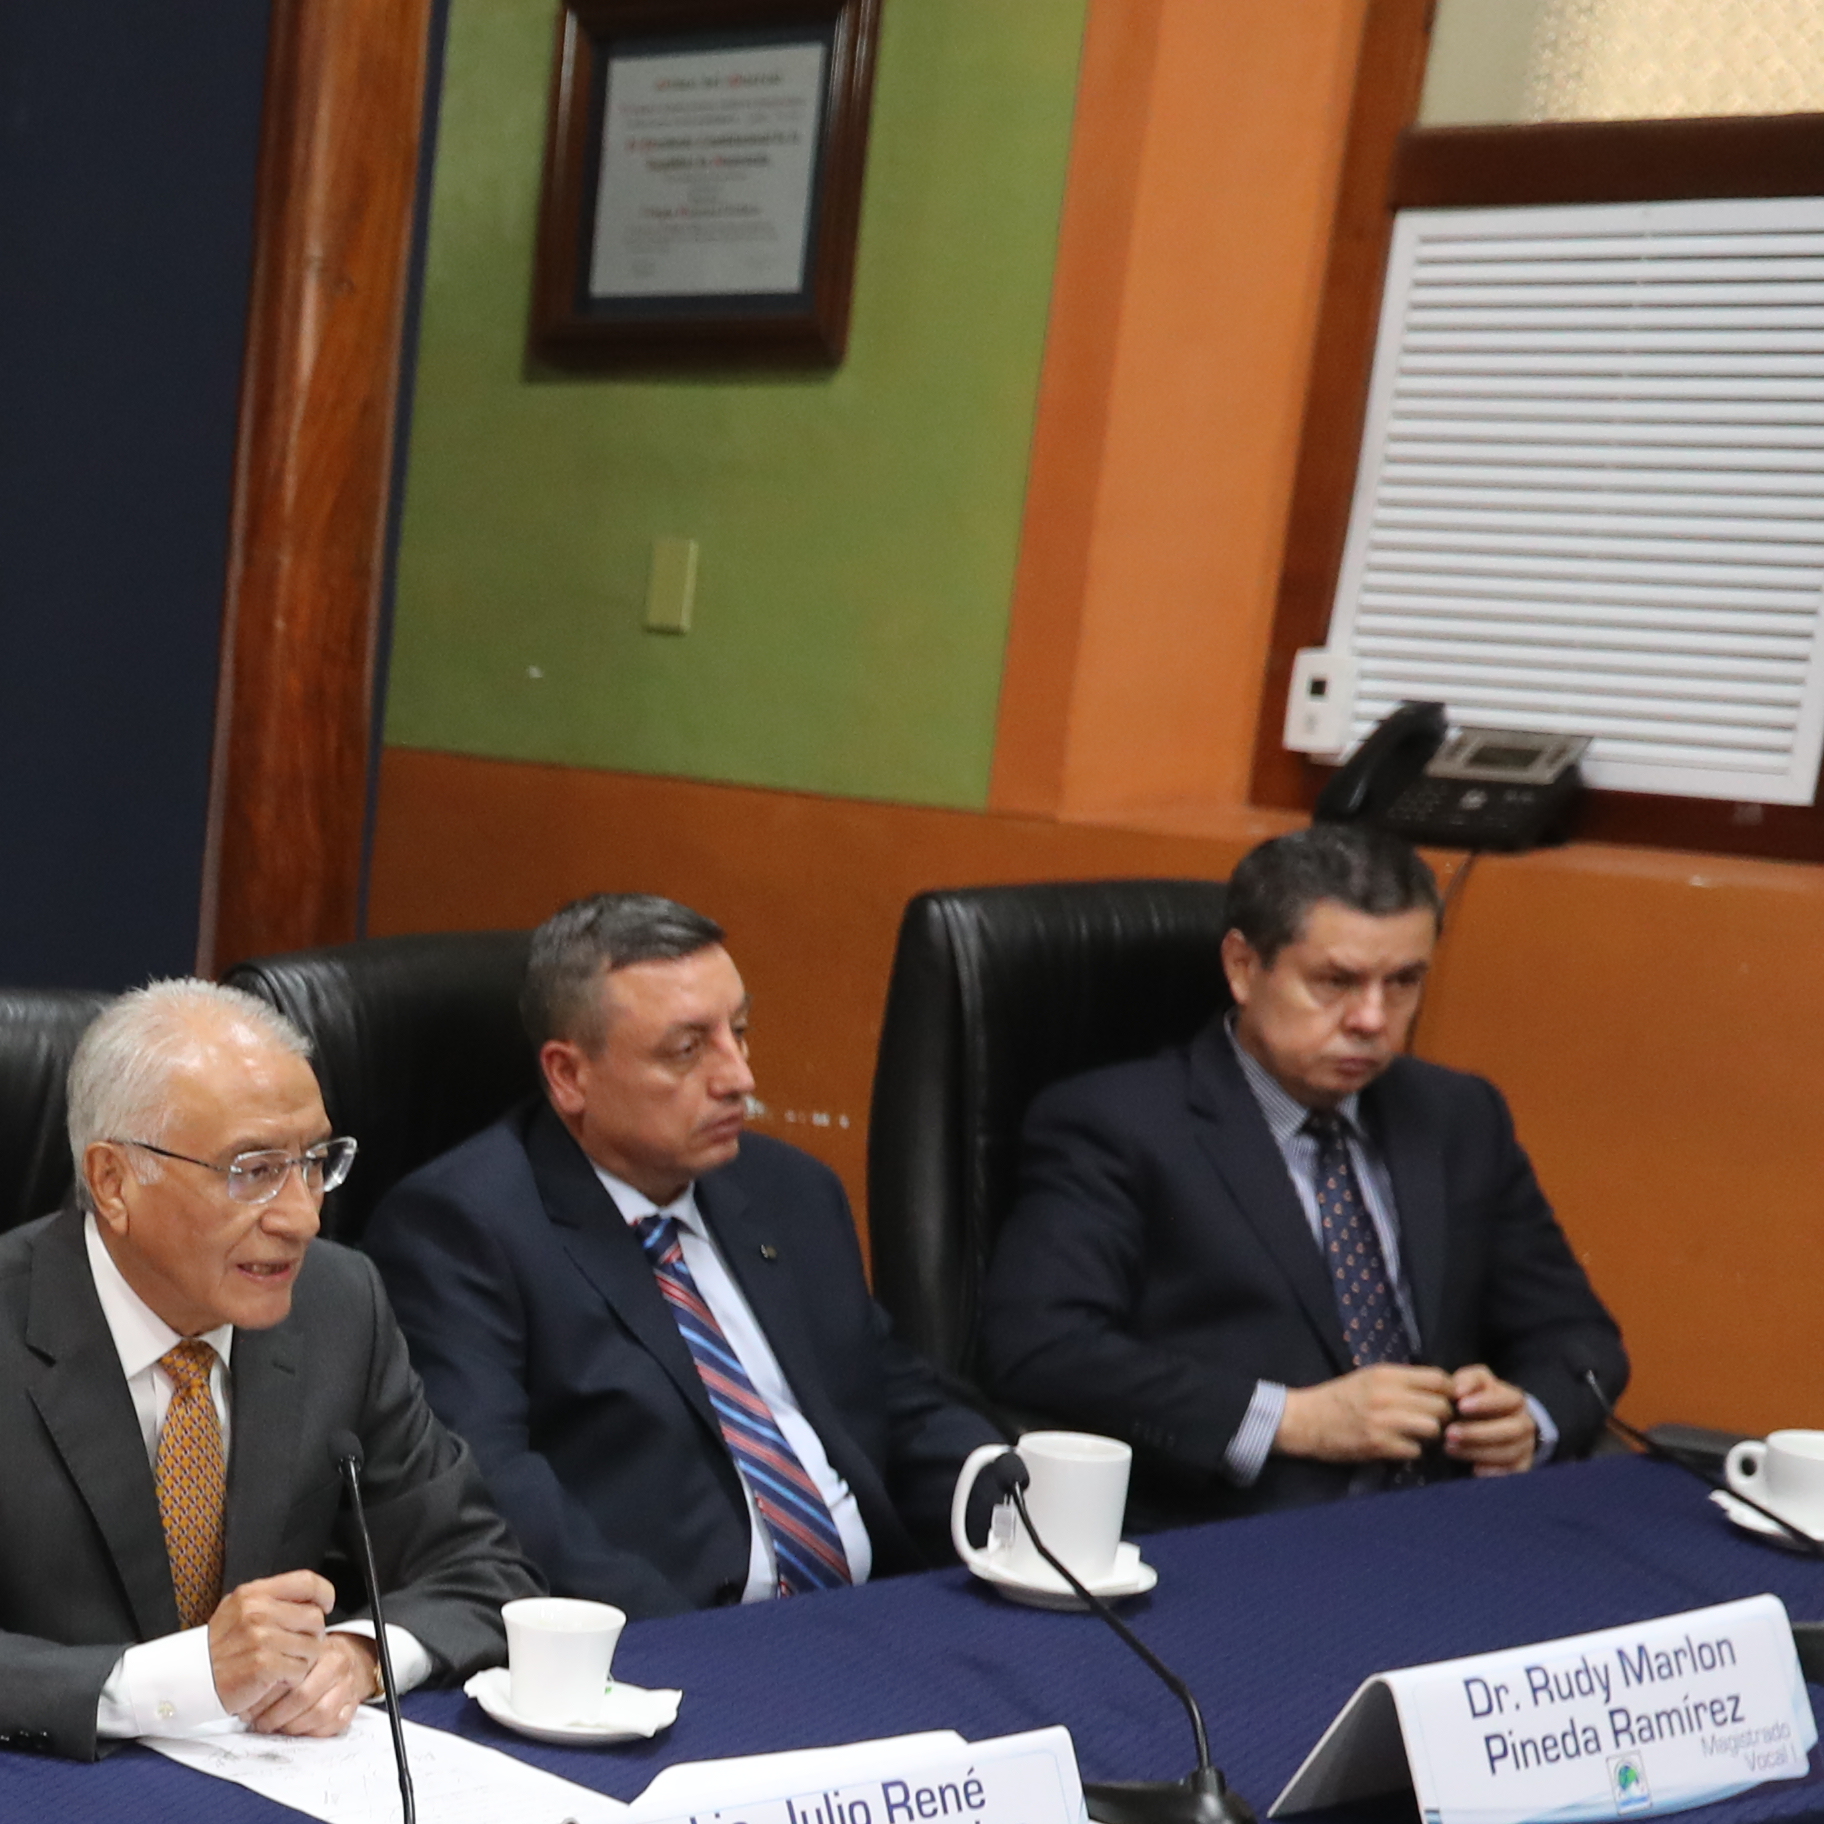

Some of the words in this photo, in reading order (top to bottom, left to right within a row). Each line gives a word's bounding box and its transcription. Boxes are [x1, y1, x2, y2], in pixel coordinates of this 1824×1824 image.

[1461, 1675, 1522, 1721] Dr.
[1523, 1654, 1612, 1708] Rudy
[1614, 1633, 1737, 1689] Marlon
[1482, 1714, 1603, 1777] Pineda
[1607, 1691, 1746, 1751] Ramírez
[1700, 1720, 1791, 1759] Magistrado
[1745, 1742, 1788, 1772] Vocal
